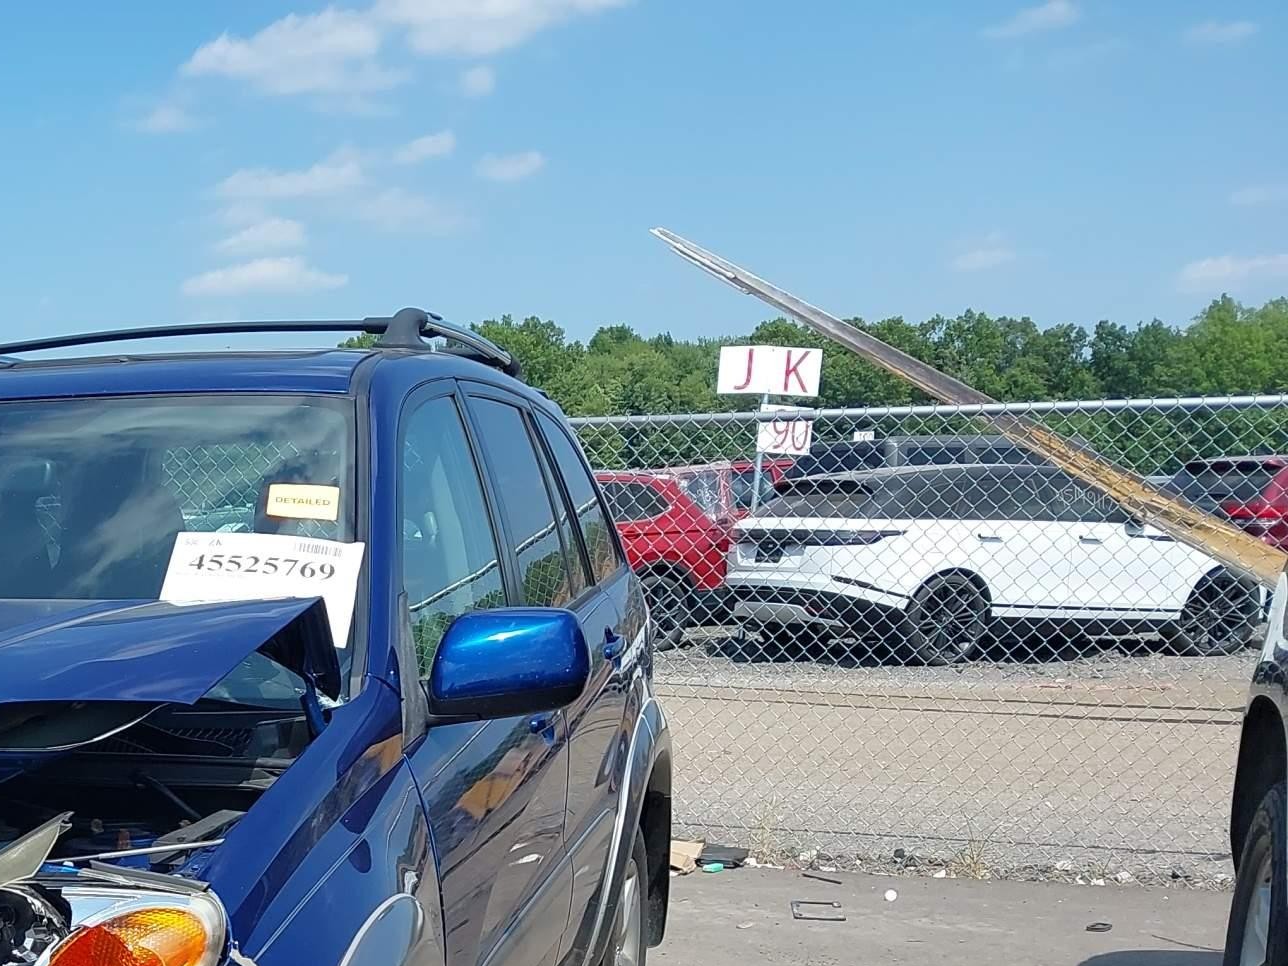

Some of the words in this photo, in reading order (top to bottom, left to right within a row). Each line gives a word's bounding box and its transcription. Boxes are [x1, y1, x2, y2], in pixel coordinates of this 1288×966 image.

[733, 348, 755, 391] J
[783, 349, 812, 394] K
[772, 408, 811, 451] 90
[274, 495, 332, 507] DETAILED
[188, 553, 337, 581] 45525769
